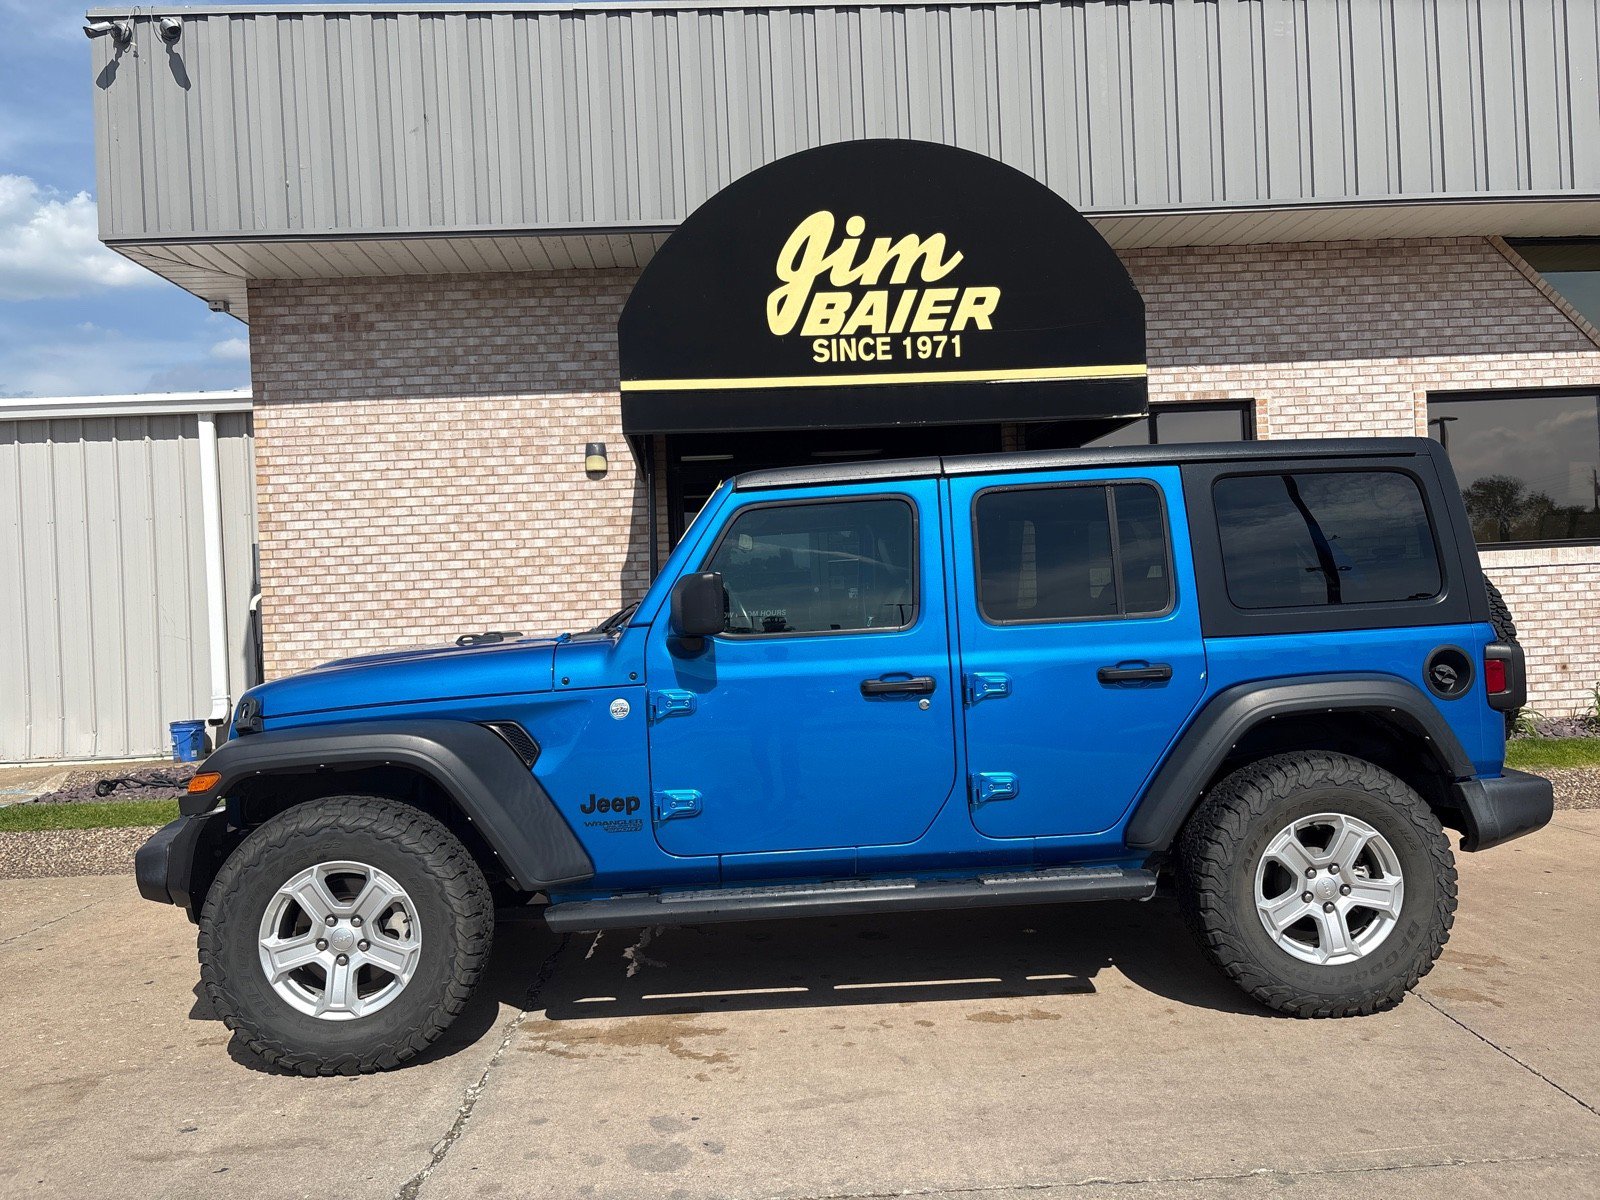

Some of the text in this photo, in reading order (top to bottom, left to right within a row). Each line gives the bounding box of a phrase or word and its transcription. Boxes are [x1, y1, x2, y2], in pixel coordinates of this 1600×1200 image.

[767, 210, 964, 336] Jim
[800, 286, 1001, 337] BAIER
[812, 334, 961, 363] SINCE 1971
[580, 794, 640, 815] Jeep
